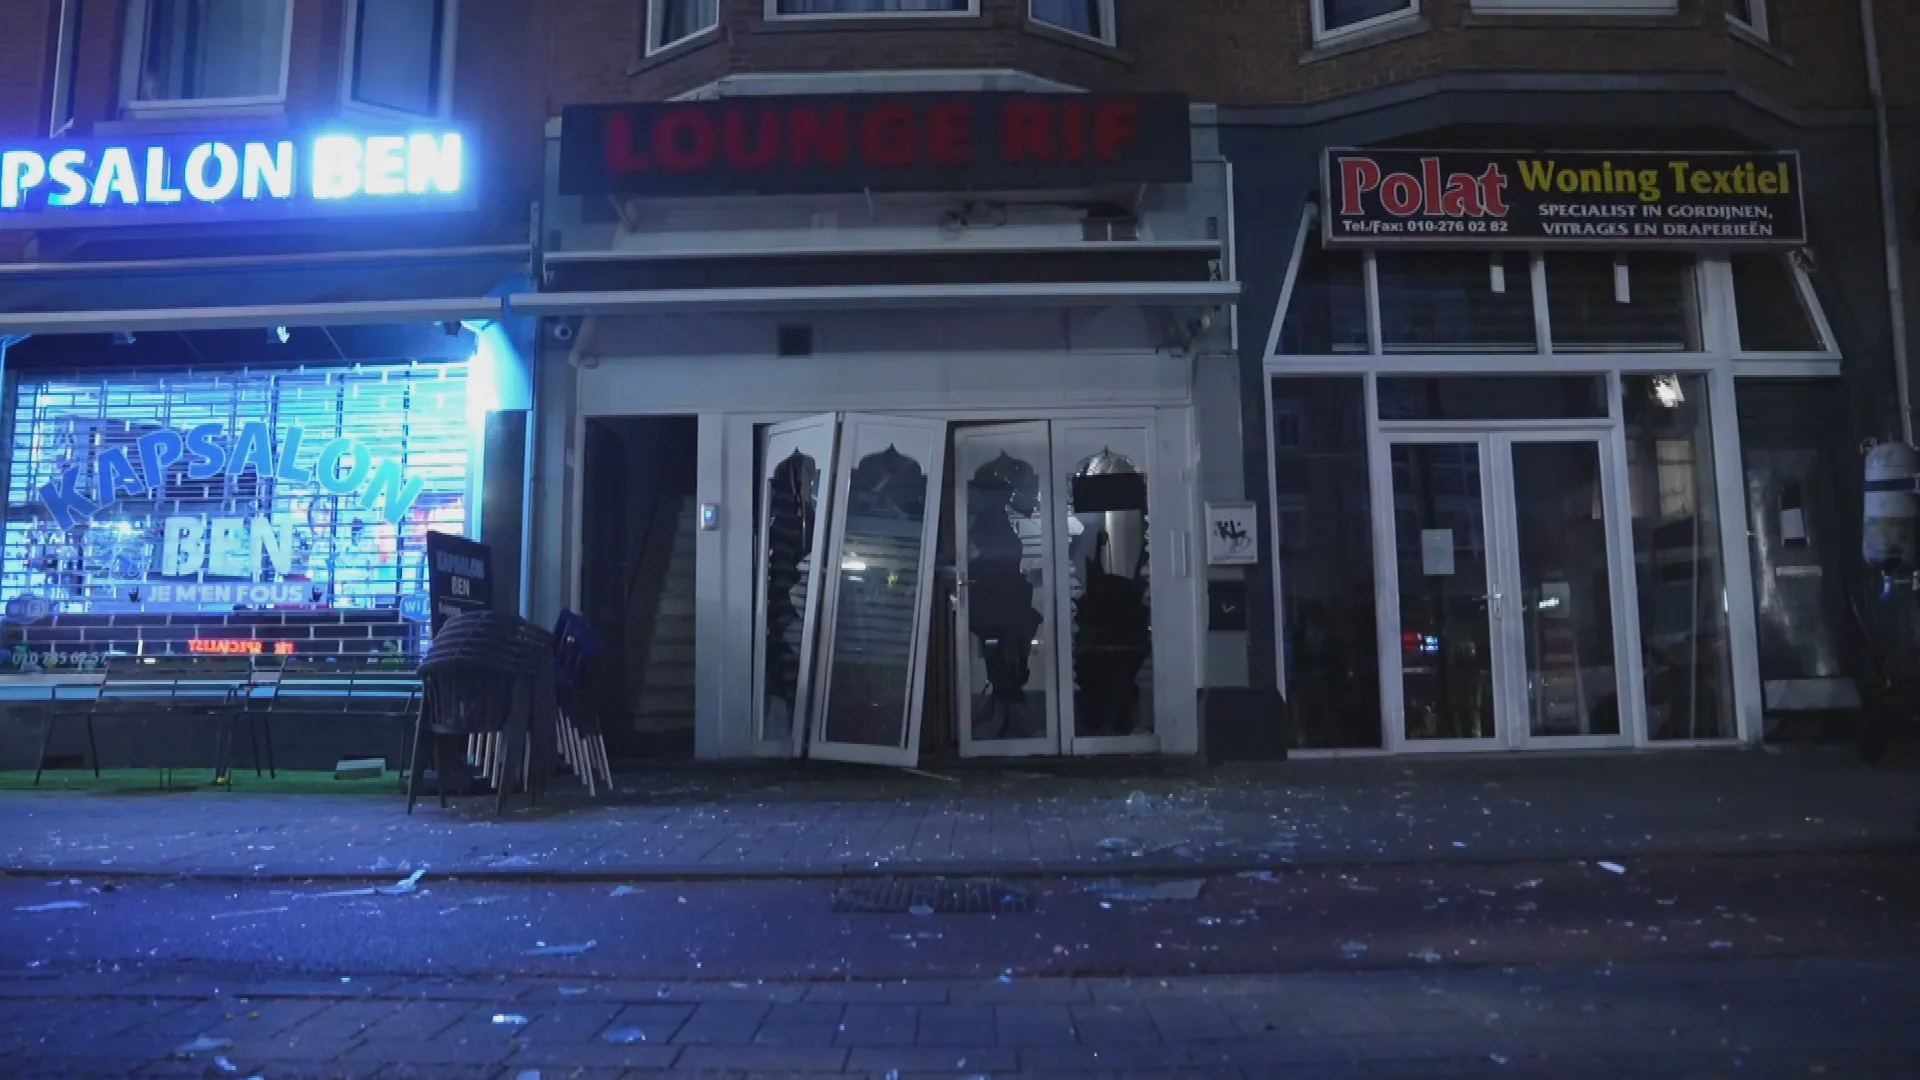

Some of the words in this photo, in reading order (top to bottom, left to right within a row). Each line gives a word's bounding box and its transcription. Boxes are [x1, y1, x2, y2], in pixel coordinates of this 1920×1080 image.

[608, 102, 975, 173] LOUNGE
[1004, 100, 1142, 166] RIF
[313, 133, 461, 198] BEN
[1517, 160, 1661, 201] Woning
[1668, 160, 1790, 194] Textiel
[1338, 157, 1510, 217] Polat
[1407, 220, 1464, 232] 010-276
[1468, 220, 1486, 231] 02
[1538, 204, 1637, 218] SPECIALIST
[1643, 204, 1662, 217] IN
[1542, 222, 1629, 236] VITRAGES
[1634, 222, 1658, 236] EN
[1663, 220, 1773, 236] DRAPERIEËN
[39, 421, 424, 532] KAPSALON
[161, 515, 293, 577] BEN
[148, 585, 172, 602] JE
[236, 585, 303, 602] FOUS
[451, 575, 470, 596] BEN
